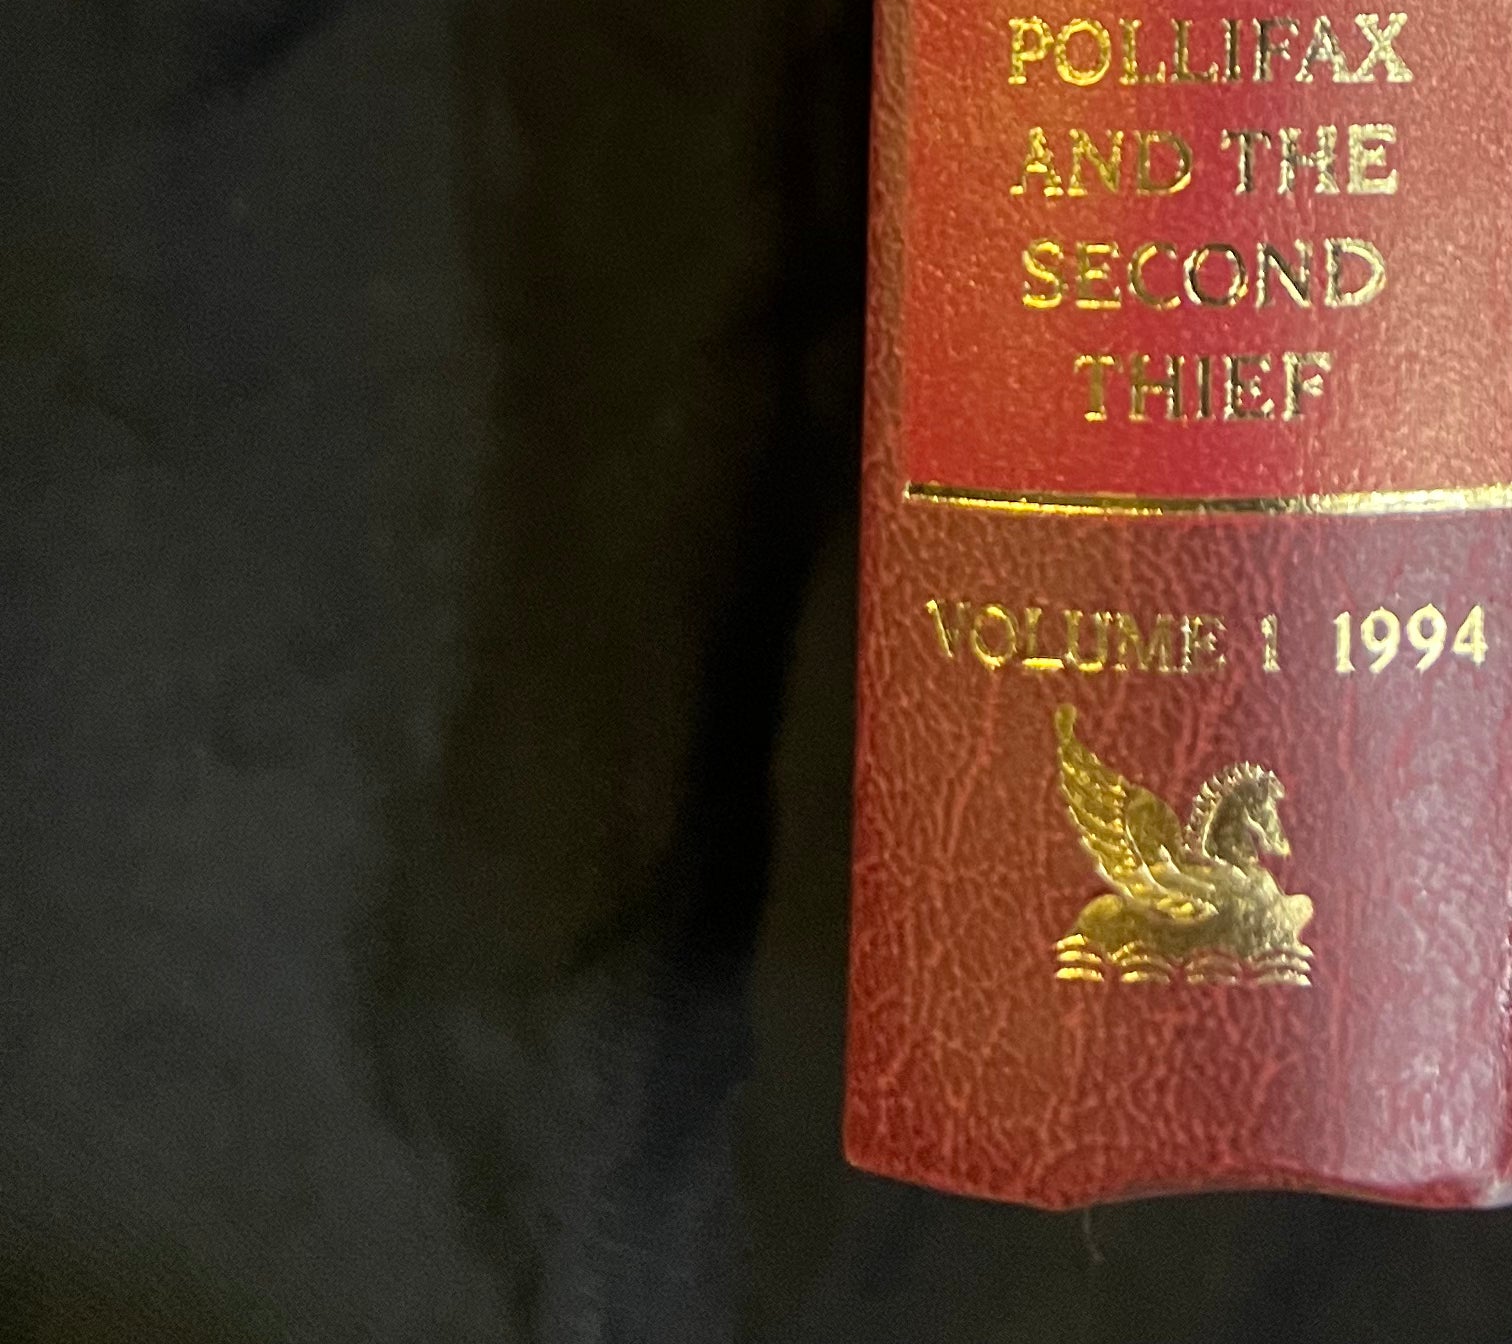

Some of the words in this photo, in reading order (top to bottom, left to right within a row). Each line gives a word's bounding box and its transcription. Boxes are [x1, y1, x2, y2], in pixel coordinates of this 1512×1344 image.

[1006, 12, 1414, 87] POLLIFAX
[1008, 125, 1193, 197] AND
[1219, 122, 1400, 196] THE
[1020, 236, 1388, 310] SECOND
[1072, 351, 1335, 424] THIEF
[925, 597, 1229, 675] VOLUME
[1260, 612, 1281, 672] 1
[1333, 602, 1489, 674] 1994
